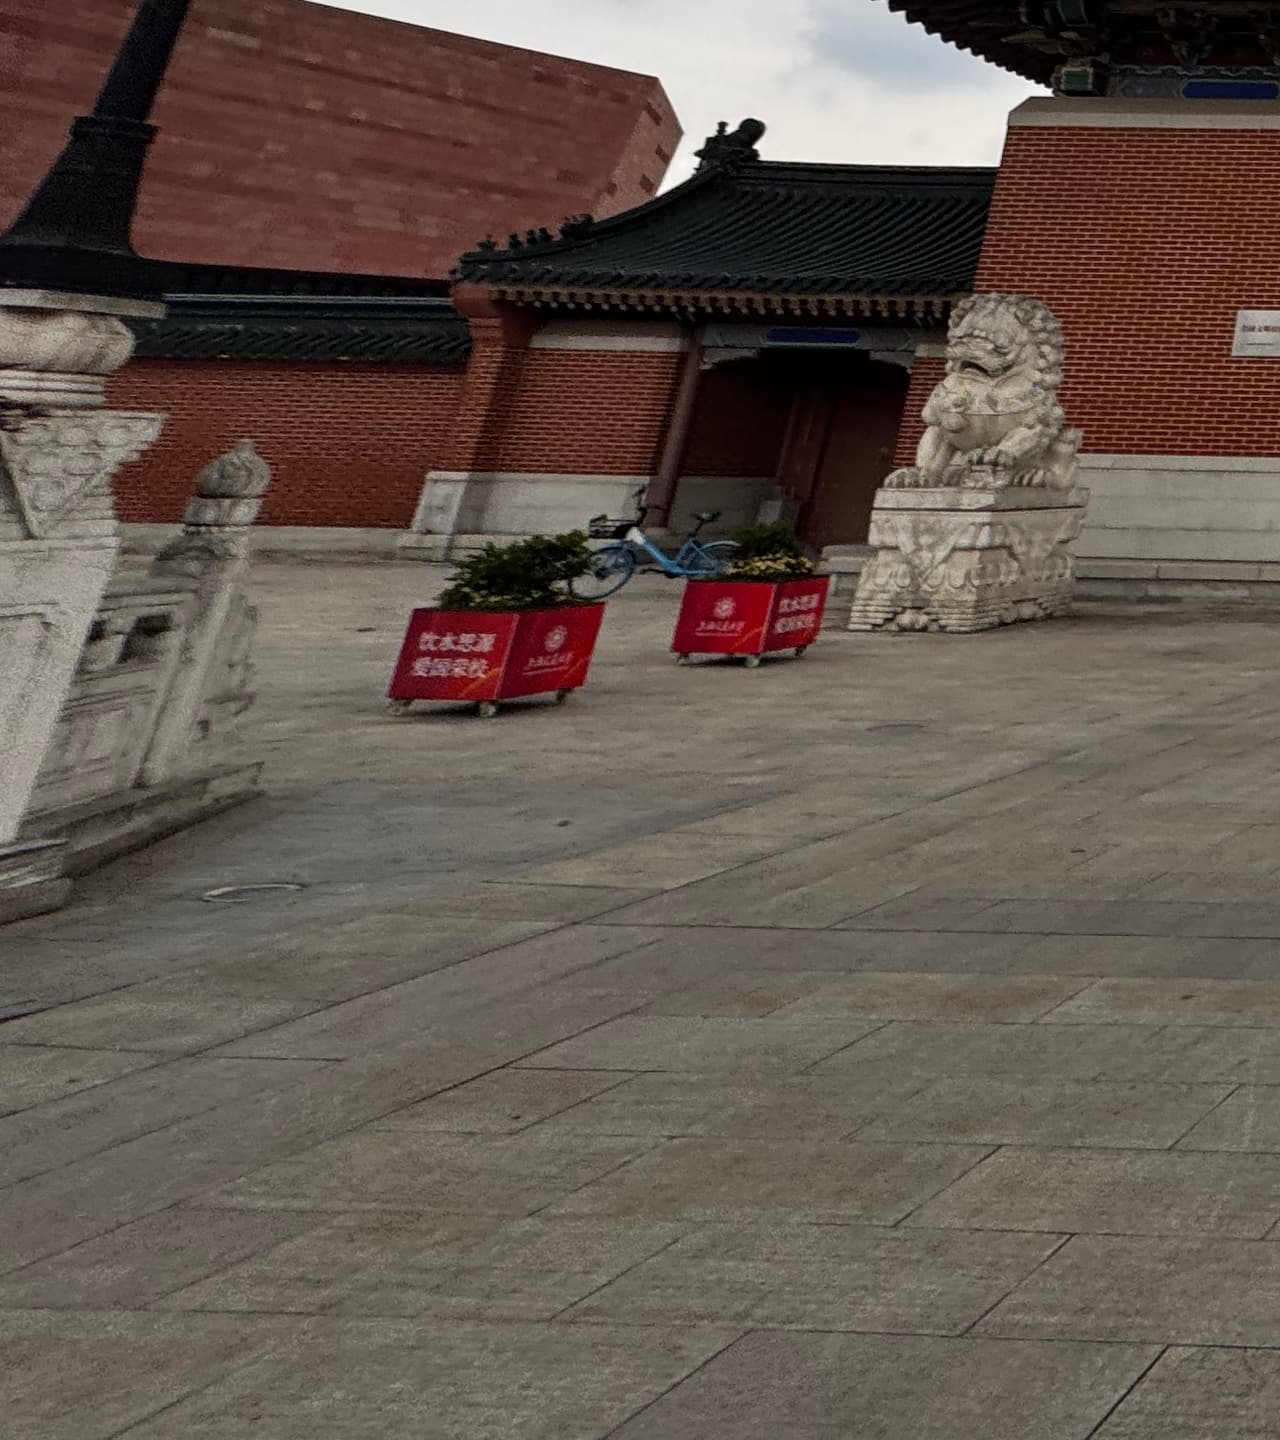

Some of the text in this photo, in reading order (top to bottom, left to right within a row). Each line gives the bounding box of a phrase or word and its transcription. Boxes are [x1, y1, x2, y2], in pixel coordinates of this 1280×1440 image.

[418, 632, 496, 652] 饮水思源
[411, 656, 489, 678] 爱国荣校
